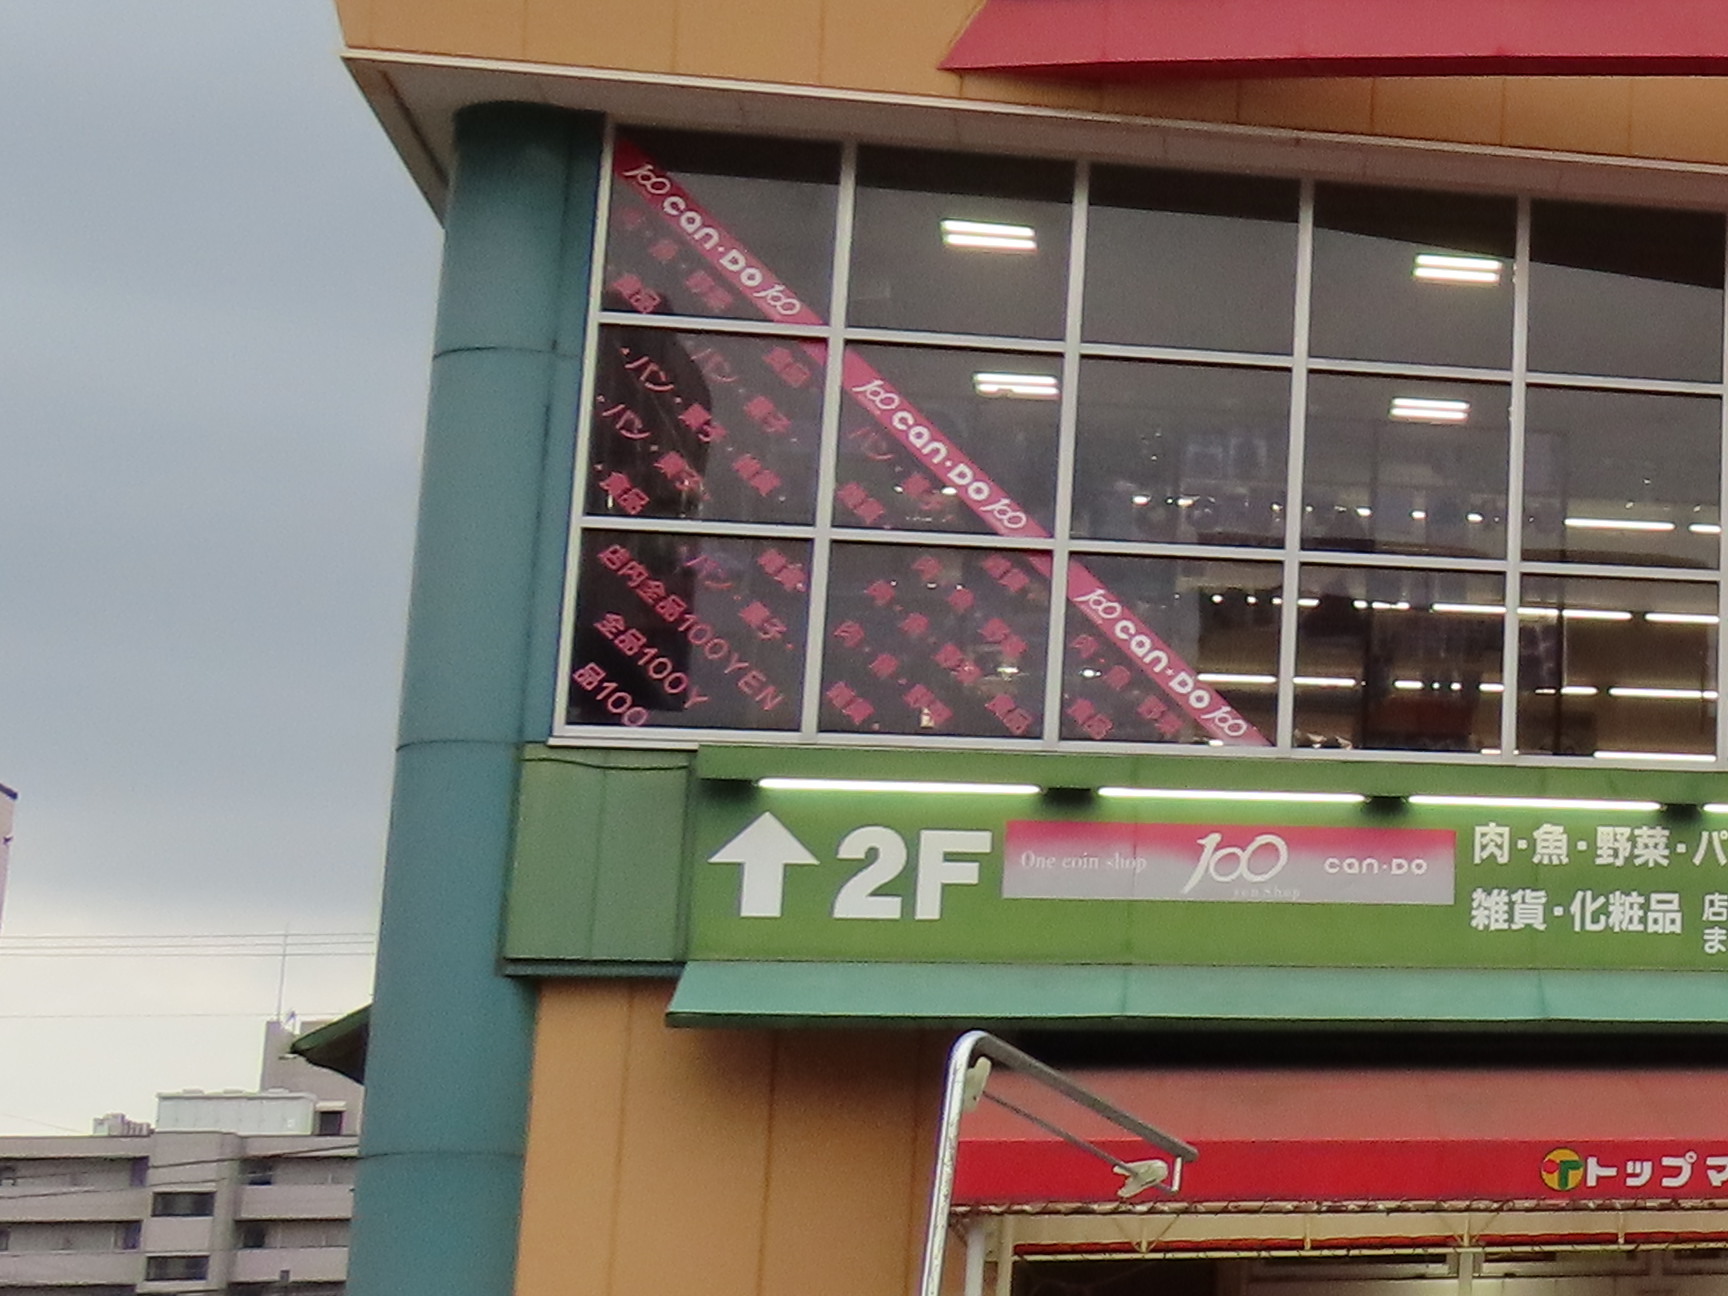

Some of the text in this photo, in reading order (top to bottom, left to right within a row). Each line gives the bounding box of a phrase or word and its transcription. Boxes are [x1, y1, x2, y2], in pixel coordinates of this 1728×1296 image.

[832, 824, 992, 920] 2F
[1020, 850, 1148, 874] One coin shop
[1182, 832, 1289, 894] 100
[1470, 886, 1683, 935] 雑貨・化粧品
